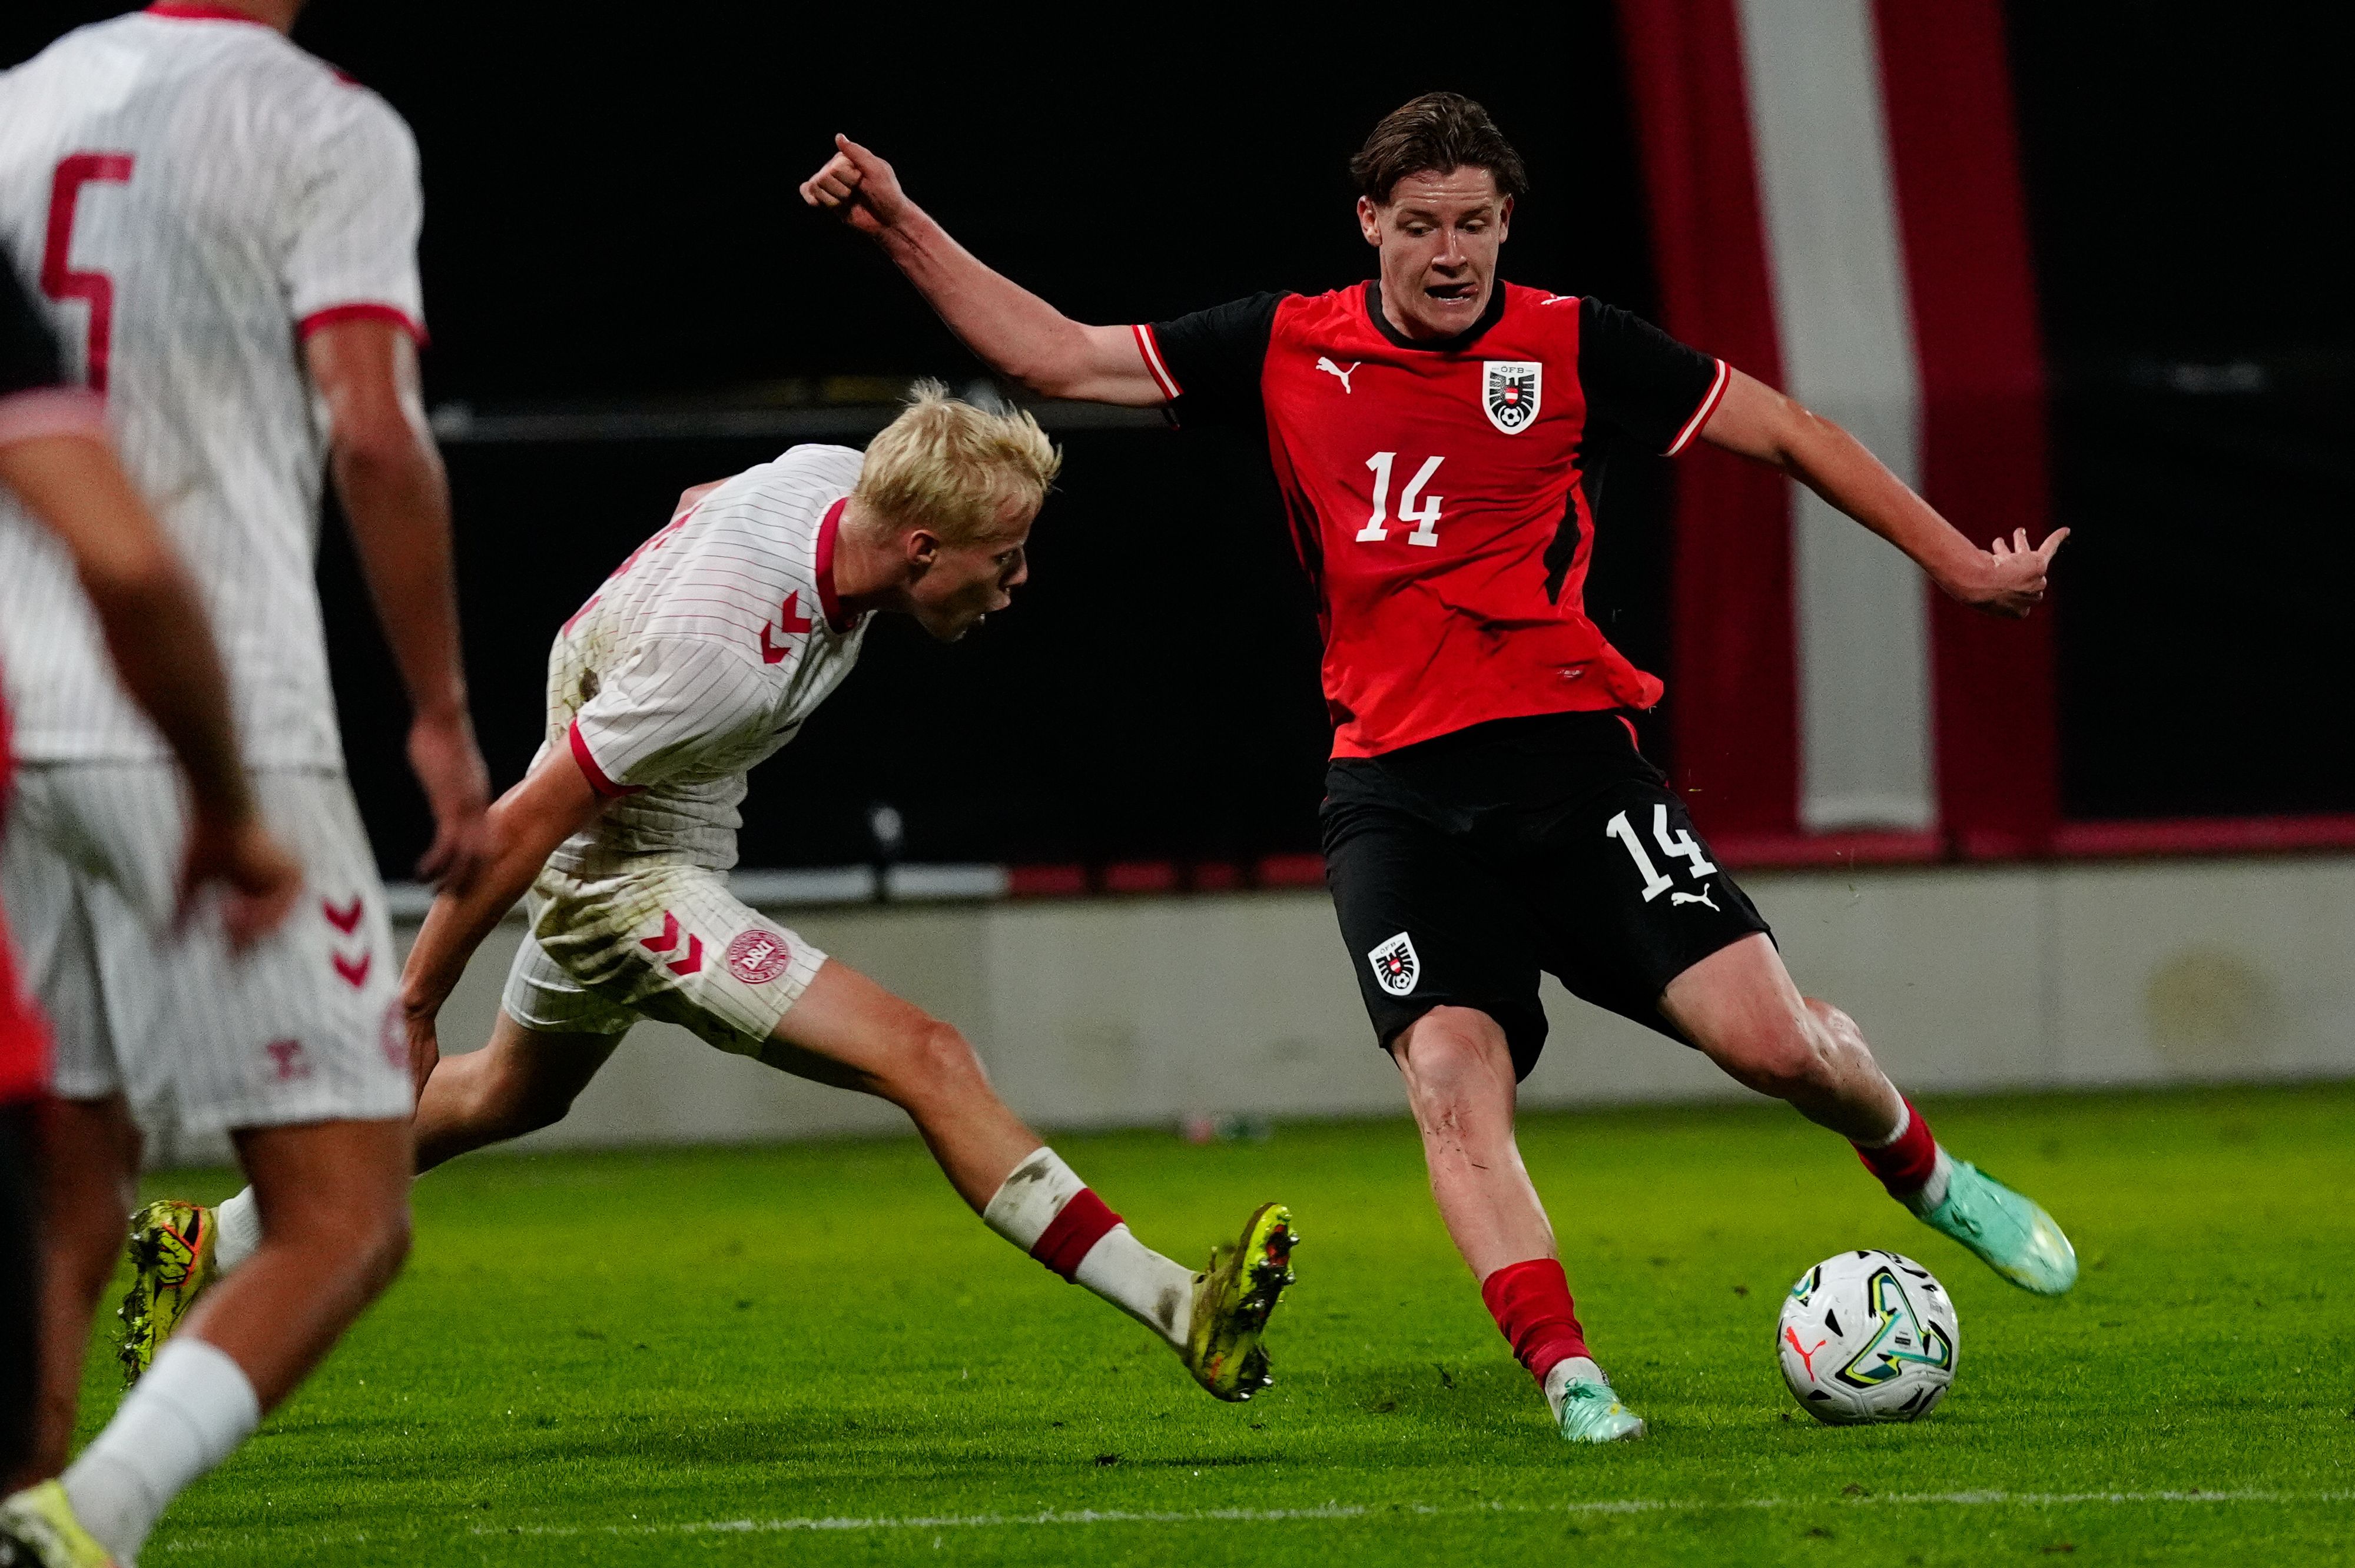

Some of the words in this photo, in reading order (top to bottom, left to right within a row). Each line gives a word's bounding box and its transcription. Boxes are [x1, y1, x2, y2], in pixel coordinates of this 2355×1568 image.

[41, 153, 134, 396] 5
[1356, 452, 1445, 547] 14
[1607, 804, 1717, 902] 14
[741, 941, 775, 971] DBU
